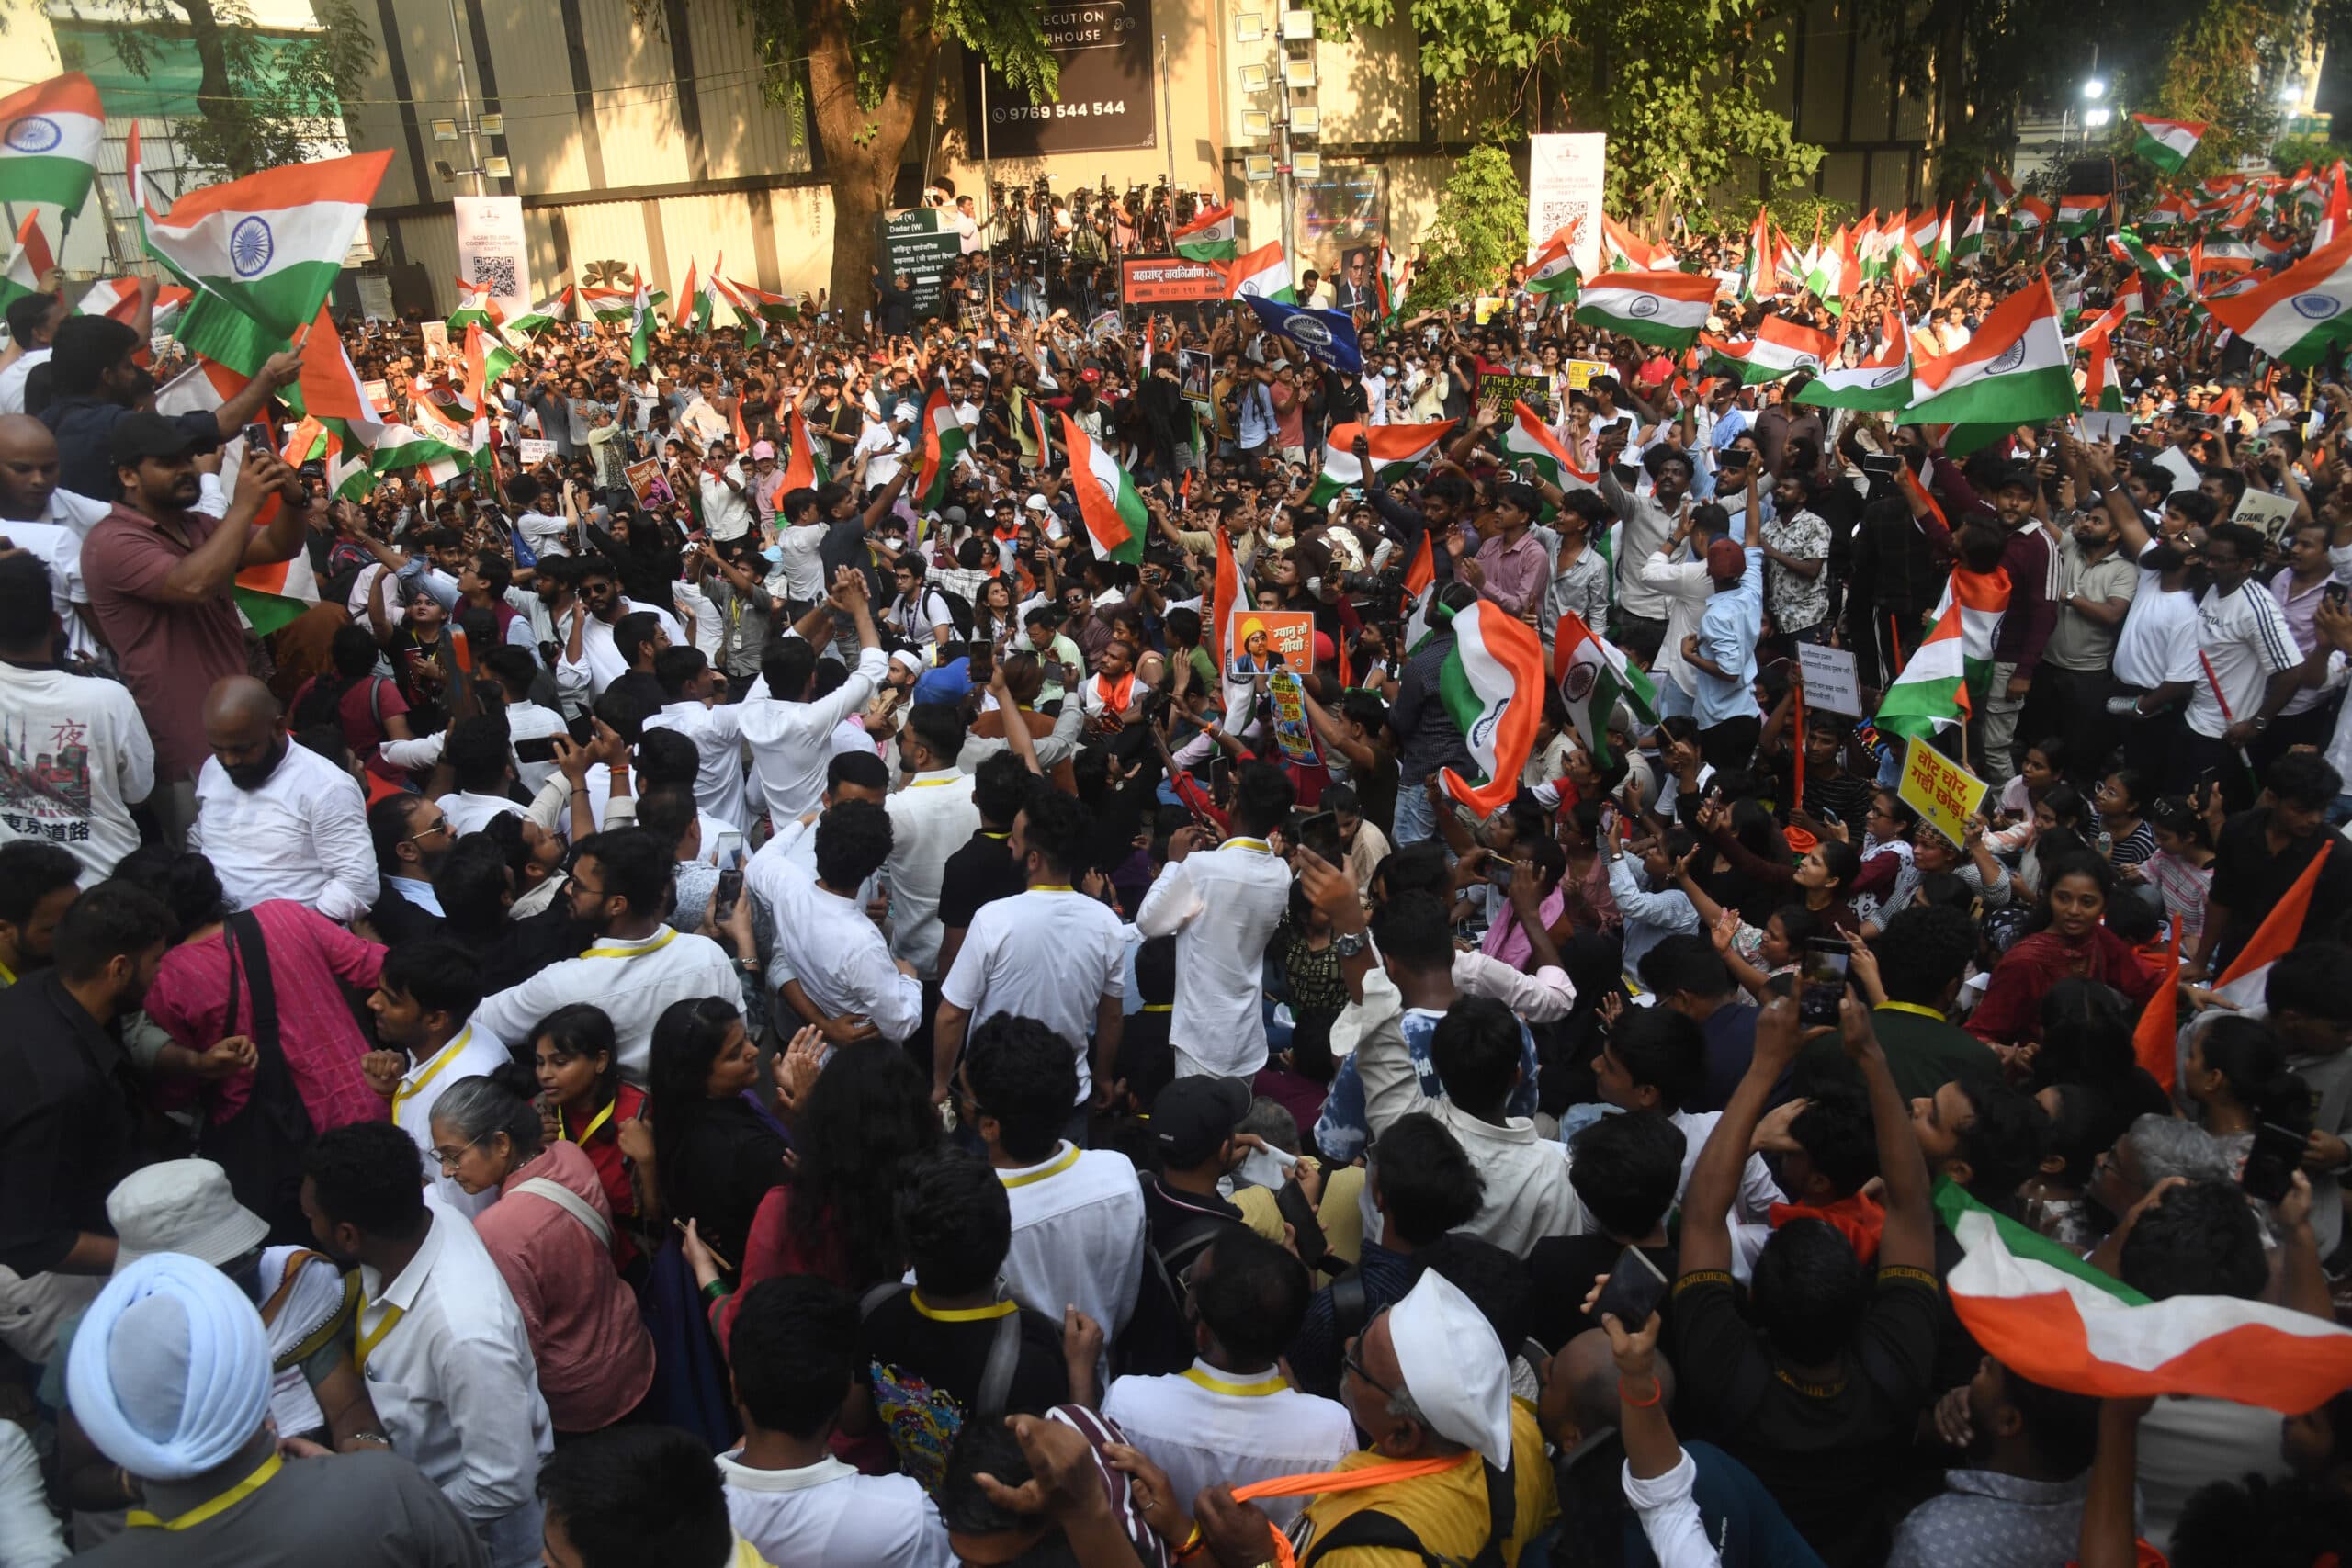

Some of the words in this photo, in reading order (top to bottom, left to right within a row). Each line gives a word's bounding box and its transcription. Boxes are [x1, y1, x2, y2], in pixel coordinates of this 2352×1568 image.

[1039, 11, 1104, 26] ECUTION
[1046, 29, 1102, 44] RHOUSE
[1009, 106, 1051, 120] 9769
[1056, 103, 1088, 118] 544
[1093, 100, 1125, 116] 544
[889, 225, 910, 233] Dadar
[910, 223, 923, 232] (W)
[1132, 269, 1164, 283] महाराष्ट्र
[1164, 265, 1204, 280] नवनिर्माण
[1481, 375, 1488, 386] IF
[1492, 375, 1510, 386] THE
[1513, 378, 1540, 389] DEAF
[1485, 387, 1503, 398] ARE
[1507, 388, 1520, 399] TO
[1502, 412, 1514, 423] TO
[1297, 621, 1308, 636] तो
[1279, 637, 1304, 653] गीयो
[50, 718, 89, 752] 夜
[1910, 765, 1935, 795] गद्दी
[1917, 749, 1941, 777] वोट
[1941, 769, 1968, 802] चोर,
